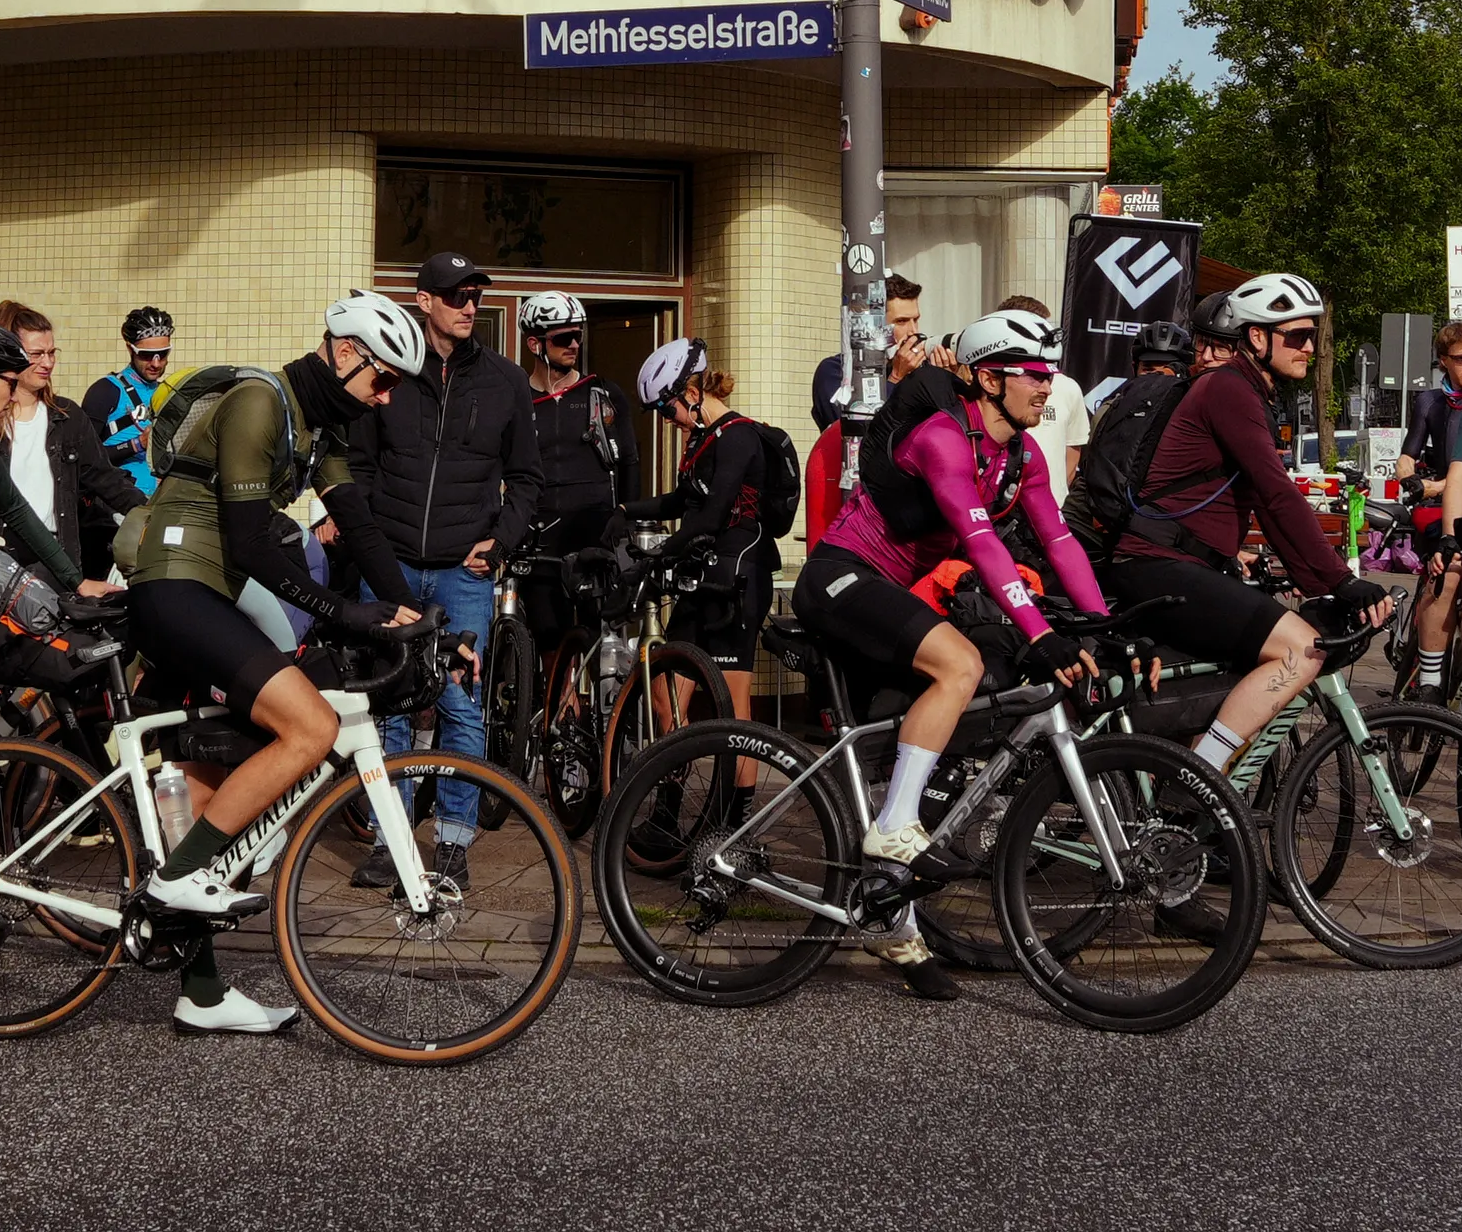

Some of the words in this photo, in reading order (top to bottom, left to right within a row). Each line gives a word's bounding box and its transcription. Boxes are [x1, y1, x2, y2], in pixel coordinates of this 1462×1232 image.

[540, 8, 820, 56] Methfesselstraße
[1123, 190, 1159, 205] GRILL
[1123, 204, 1160, 212] CENTER
[1087, 318, 1143, 336] LEE
[965, 338, 1009, 363] S-WORKS
[279, 577, 336, 618] TRIPE2
[727, 734, 772, 756] SWISS
[1229, 705, 1306, 793] ANYON
[404, 764, 435, 776] SWISS
[436, 765, 455, 776] DT
[770, 750, 797, 770] DT
[362, 767, 384, 785] 014
[1177, 768, 1219, 805] SWISS
[213, 766, 327, 883] SPECIALIZED
[1212, 807, 1236, 830] DT
